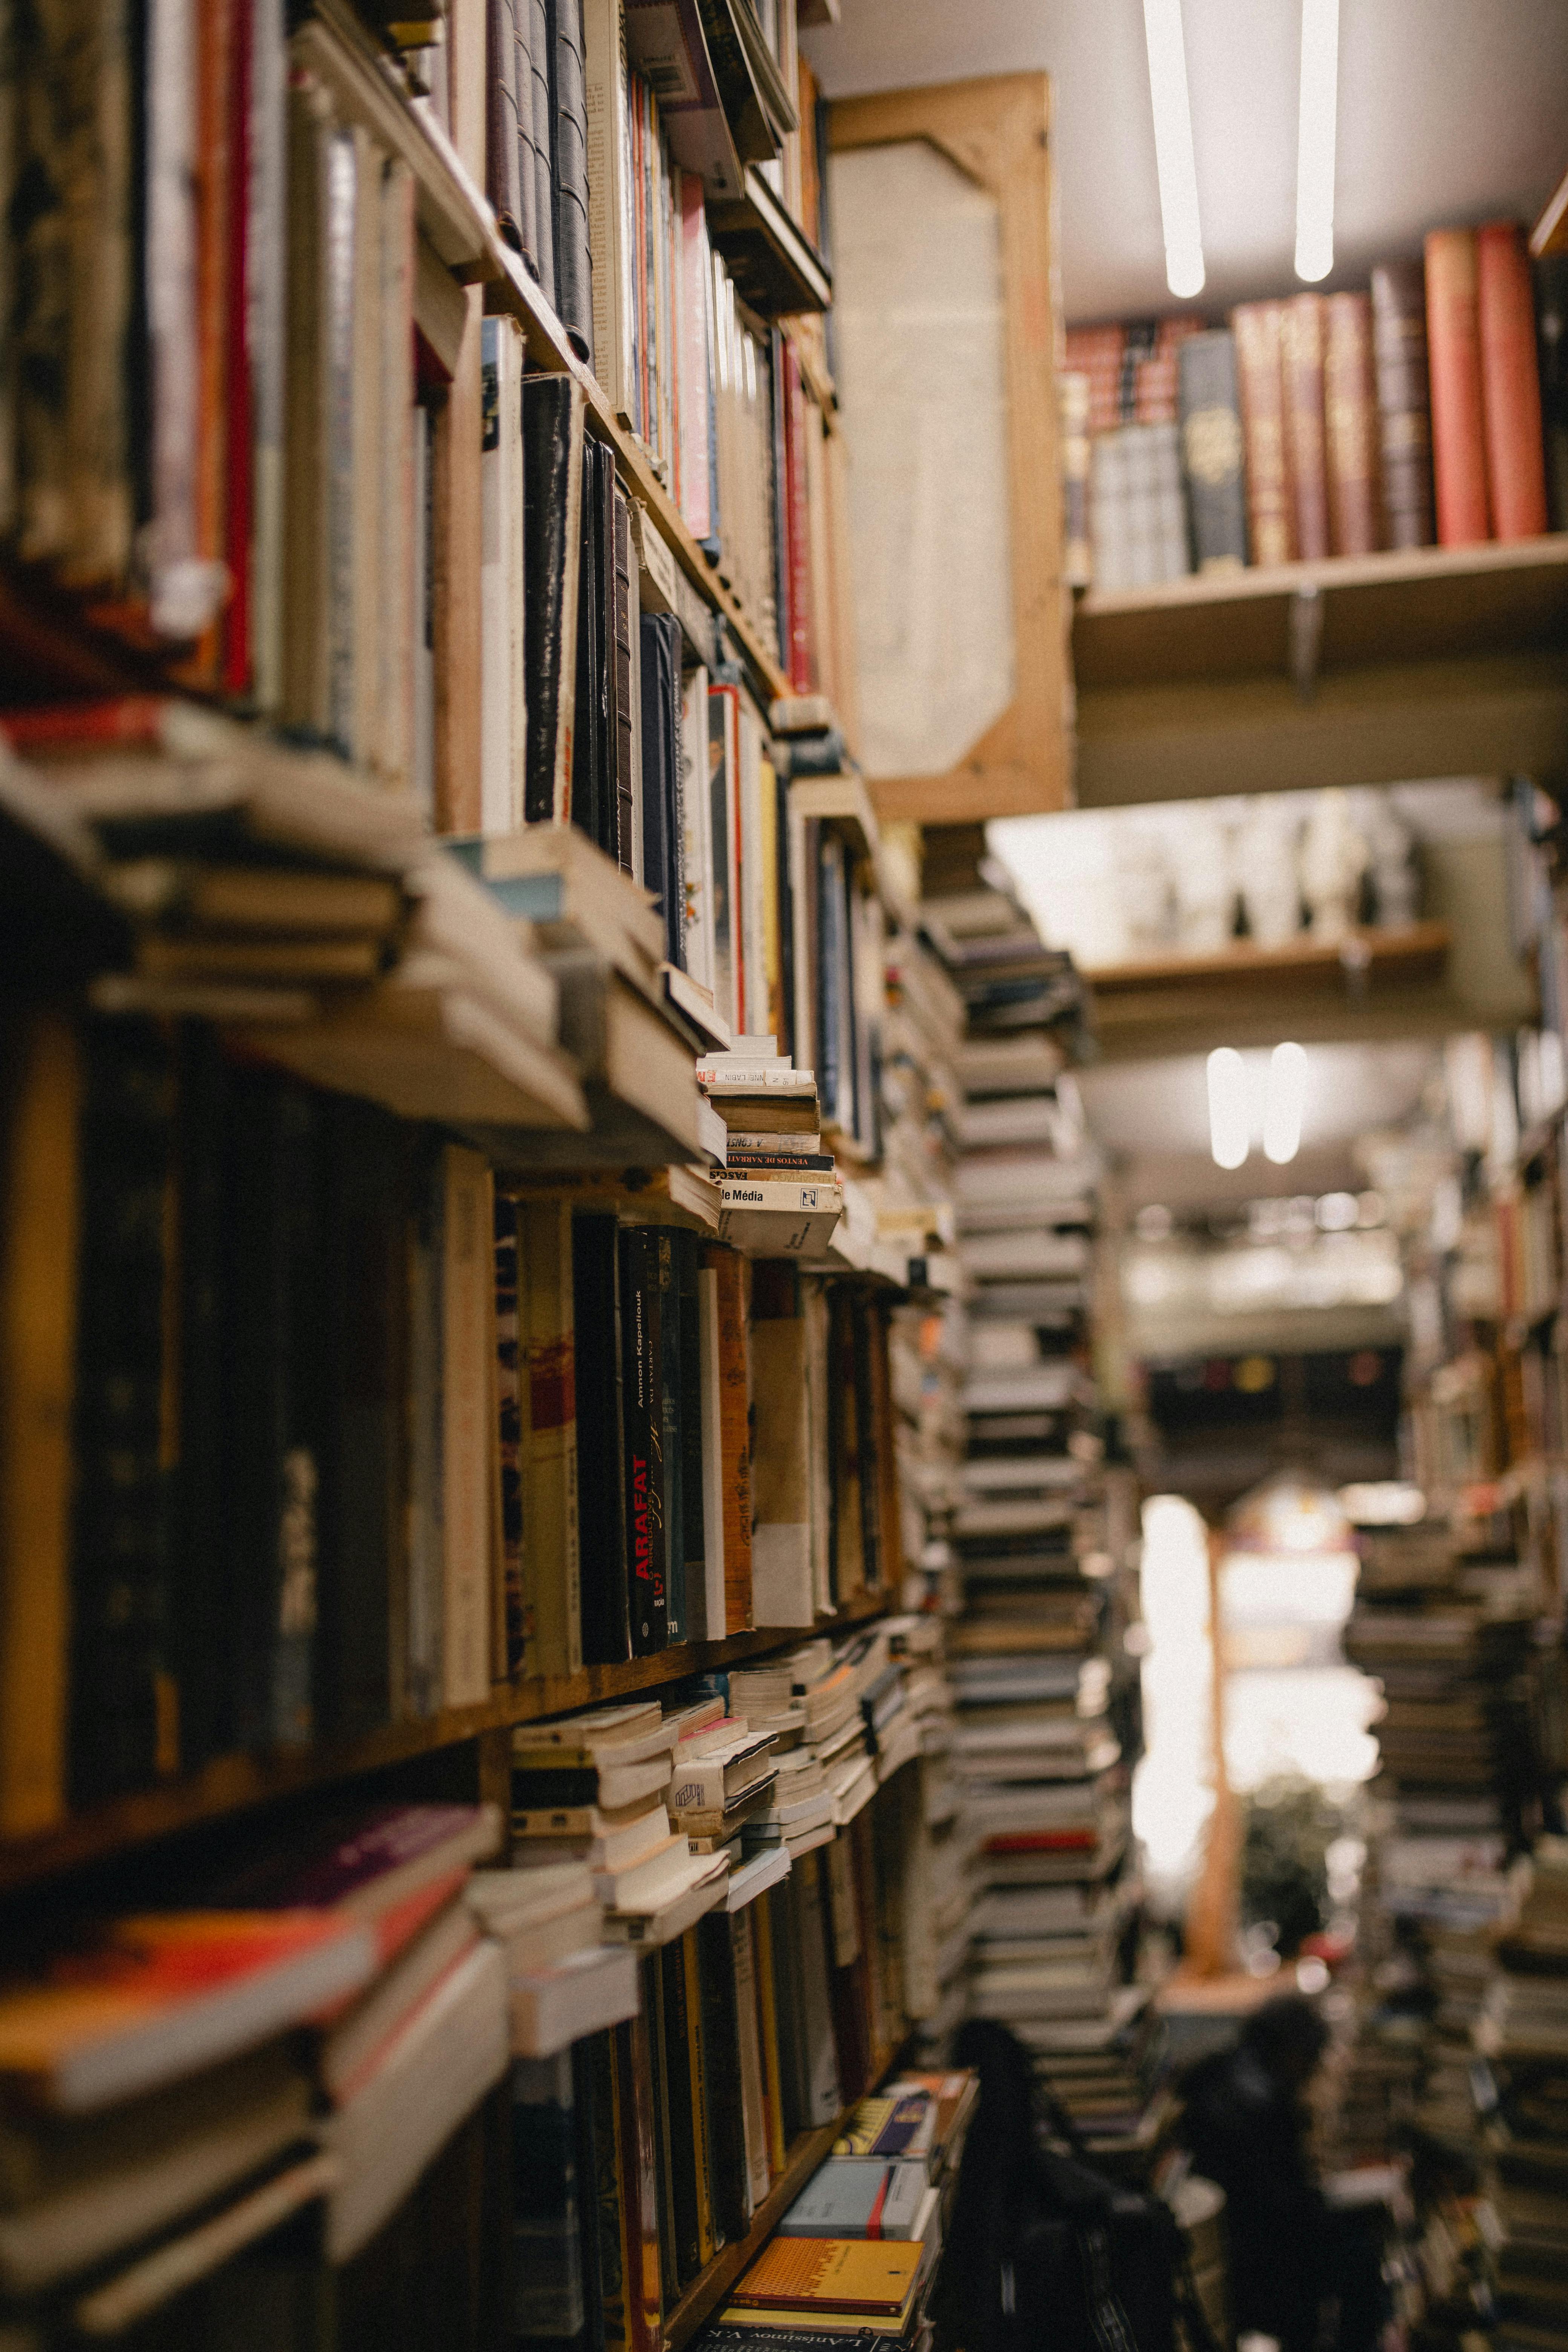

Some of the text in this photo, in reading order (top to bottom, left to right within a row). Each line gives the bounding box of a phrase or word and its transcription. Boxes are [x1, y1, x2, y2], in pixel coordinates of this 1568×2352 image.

[757, 1138, 764, 1147] A
[733, 1190, 763, 1201] Média
[649, 1389, 654, 1403] DA
[633, 1454, 649, 1580] ARAFAT
